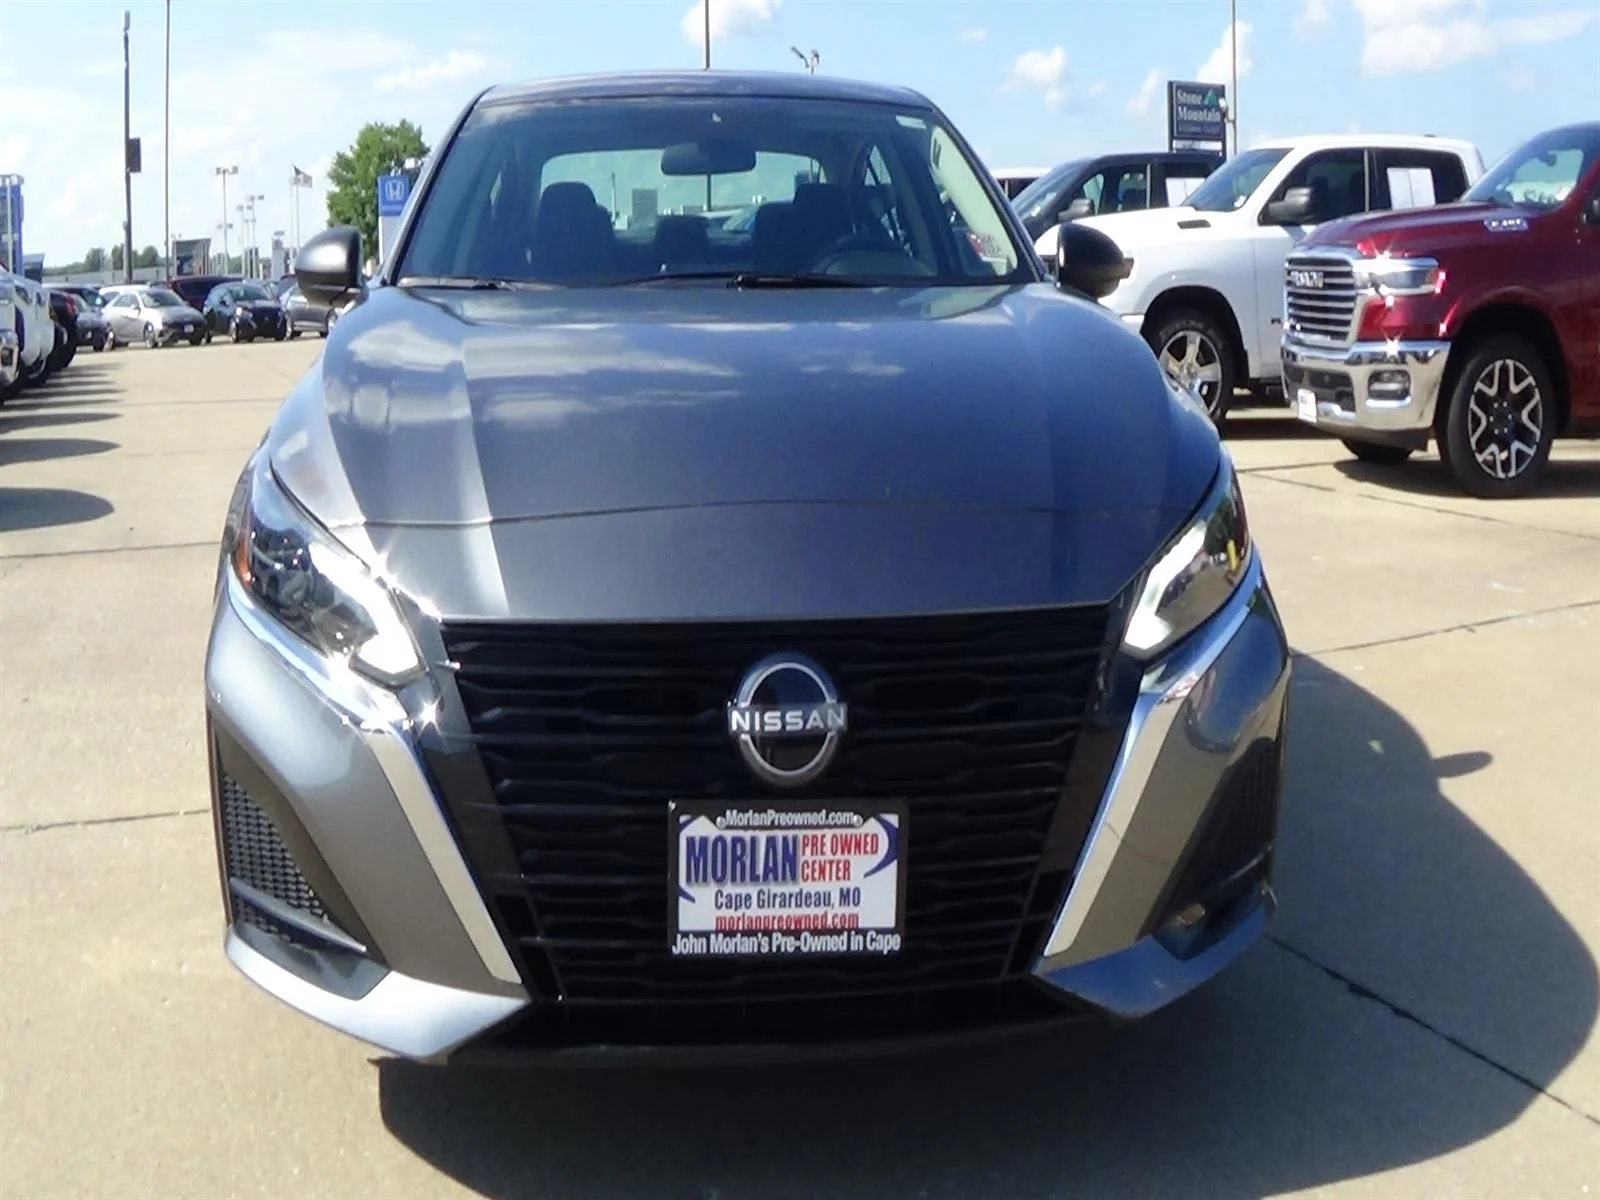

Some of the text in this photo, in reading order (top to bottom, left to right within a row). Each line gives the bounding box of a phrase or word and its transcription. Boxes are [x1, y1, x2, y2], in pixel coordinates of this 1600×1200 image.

[1177, 89, 1203, 105] Stone
[1178, 106, 1221, 122] Mountain
[731, 707, 845, 732] NISSAN
[725, 808, 854, 827] MorlanPreowned.com
[802, 833, 879, 856] PRE OWNED
[686, 834, 798, 884] MORLAN
[801, 859, 851, 882] CENTER
[714, 886, 861, 911] Cape Girardeau, MO
[715, 911, 859, 930] morlanpreowned.com
[672, 930, 901, 955] John Morlan's Pre-Owned in Cape
